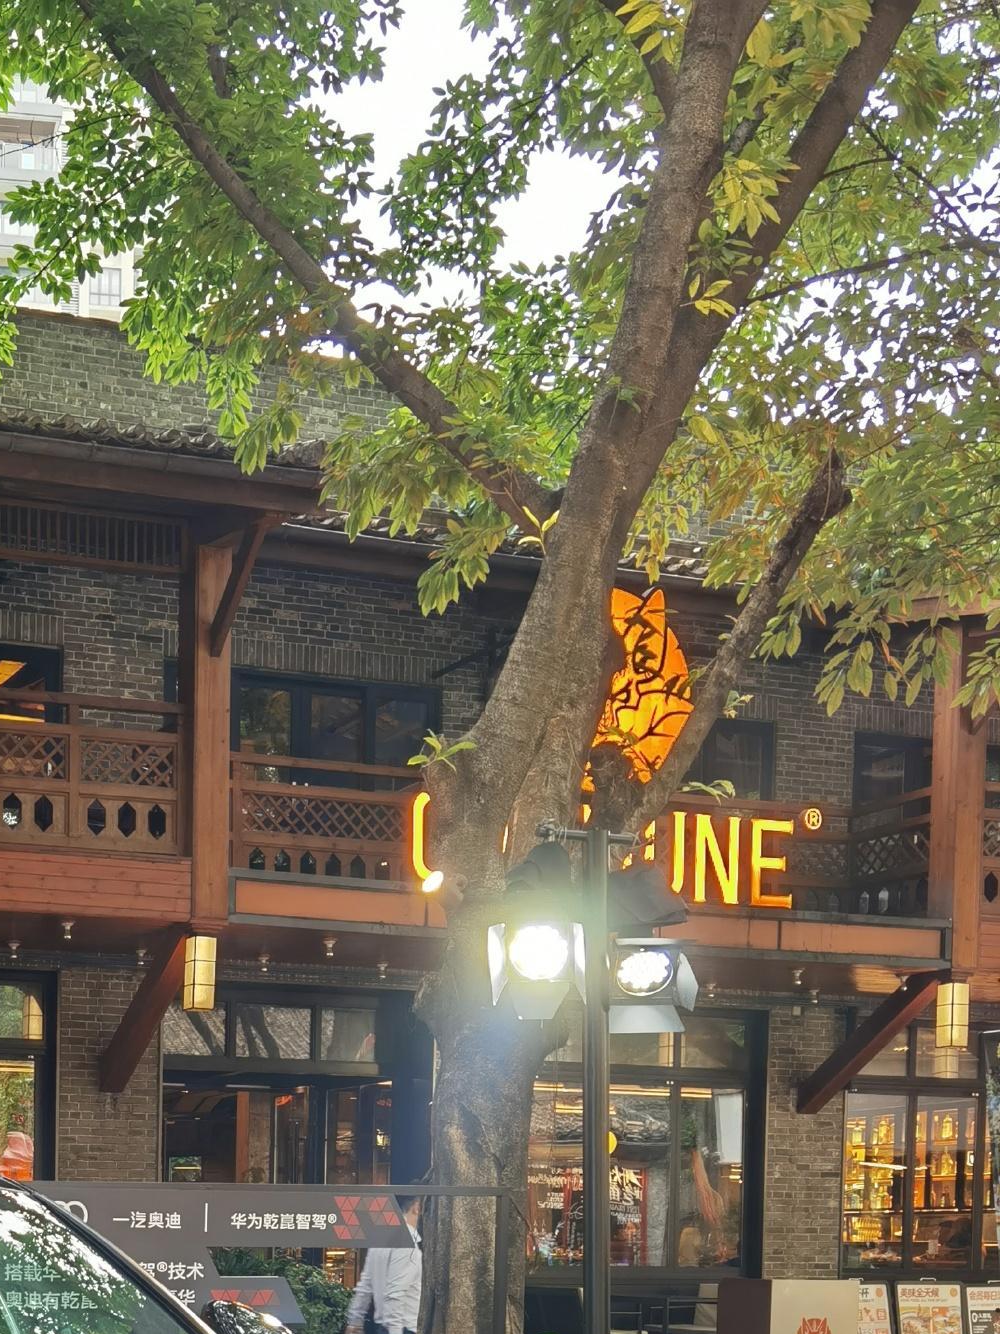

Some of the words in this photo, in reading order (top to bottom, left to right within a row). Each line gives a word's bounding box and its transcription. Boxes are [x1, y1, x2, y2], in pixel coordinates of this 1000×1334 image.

[112, 1211, 182, 1229] 一汽奥迪
[4, 1263, 66, 1282] 搭载华
[969, 1290, 1000, 1300] 会员每日
